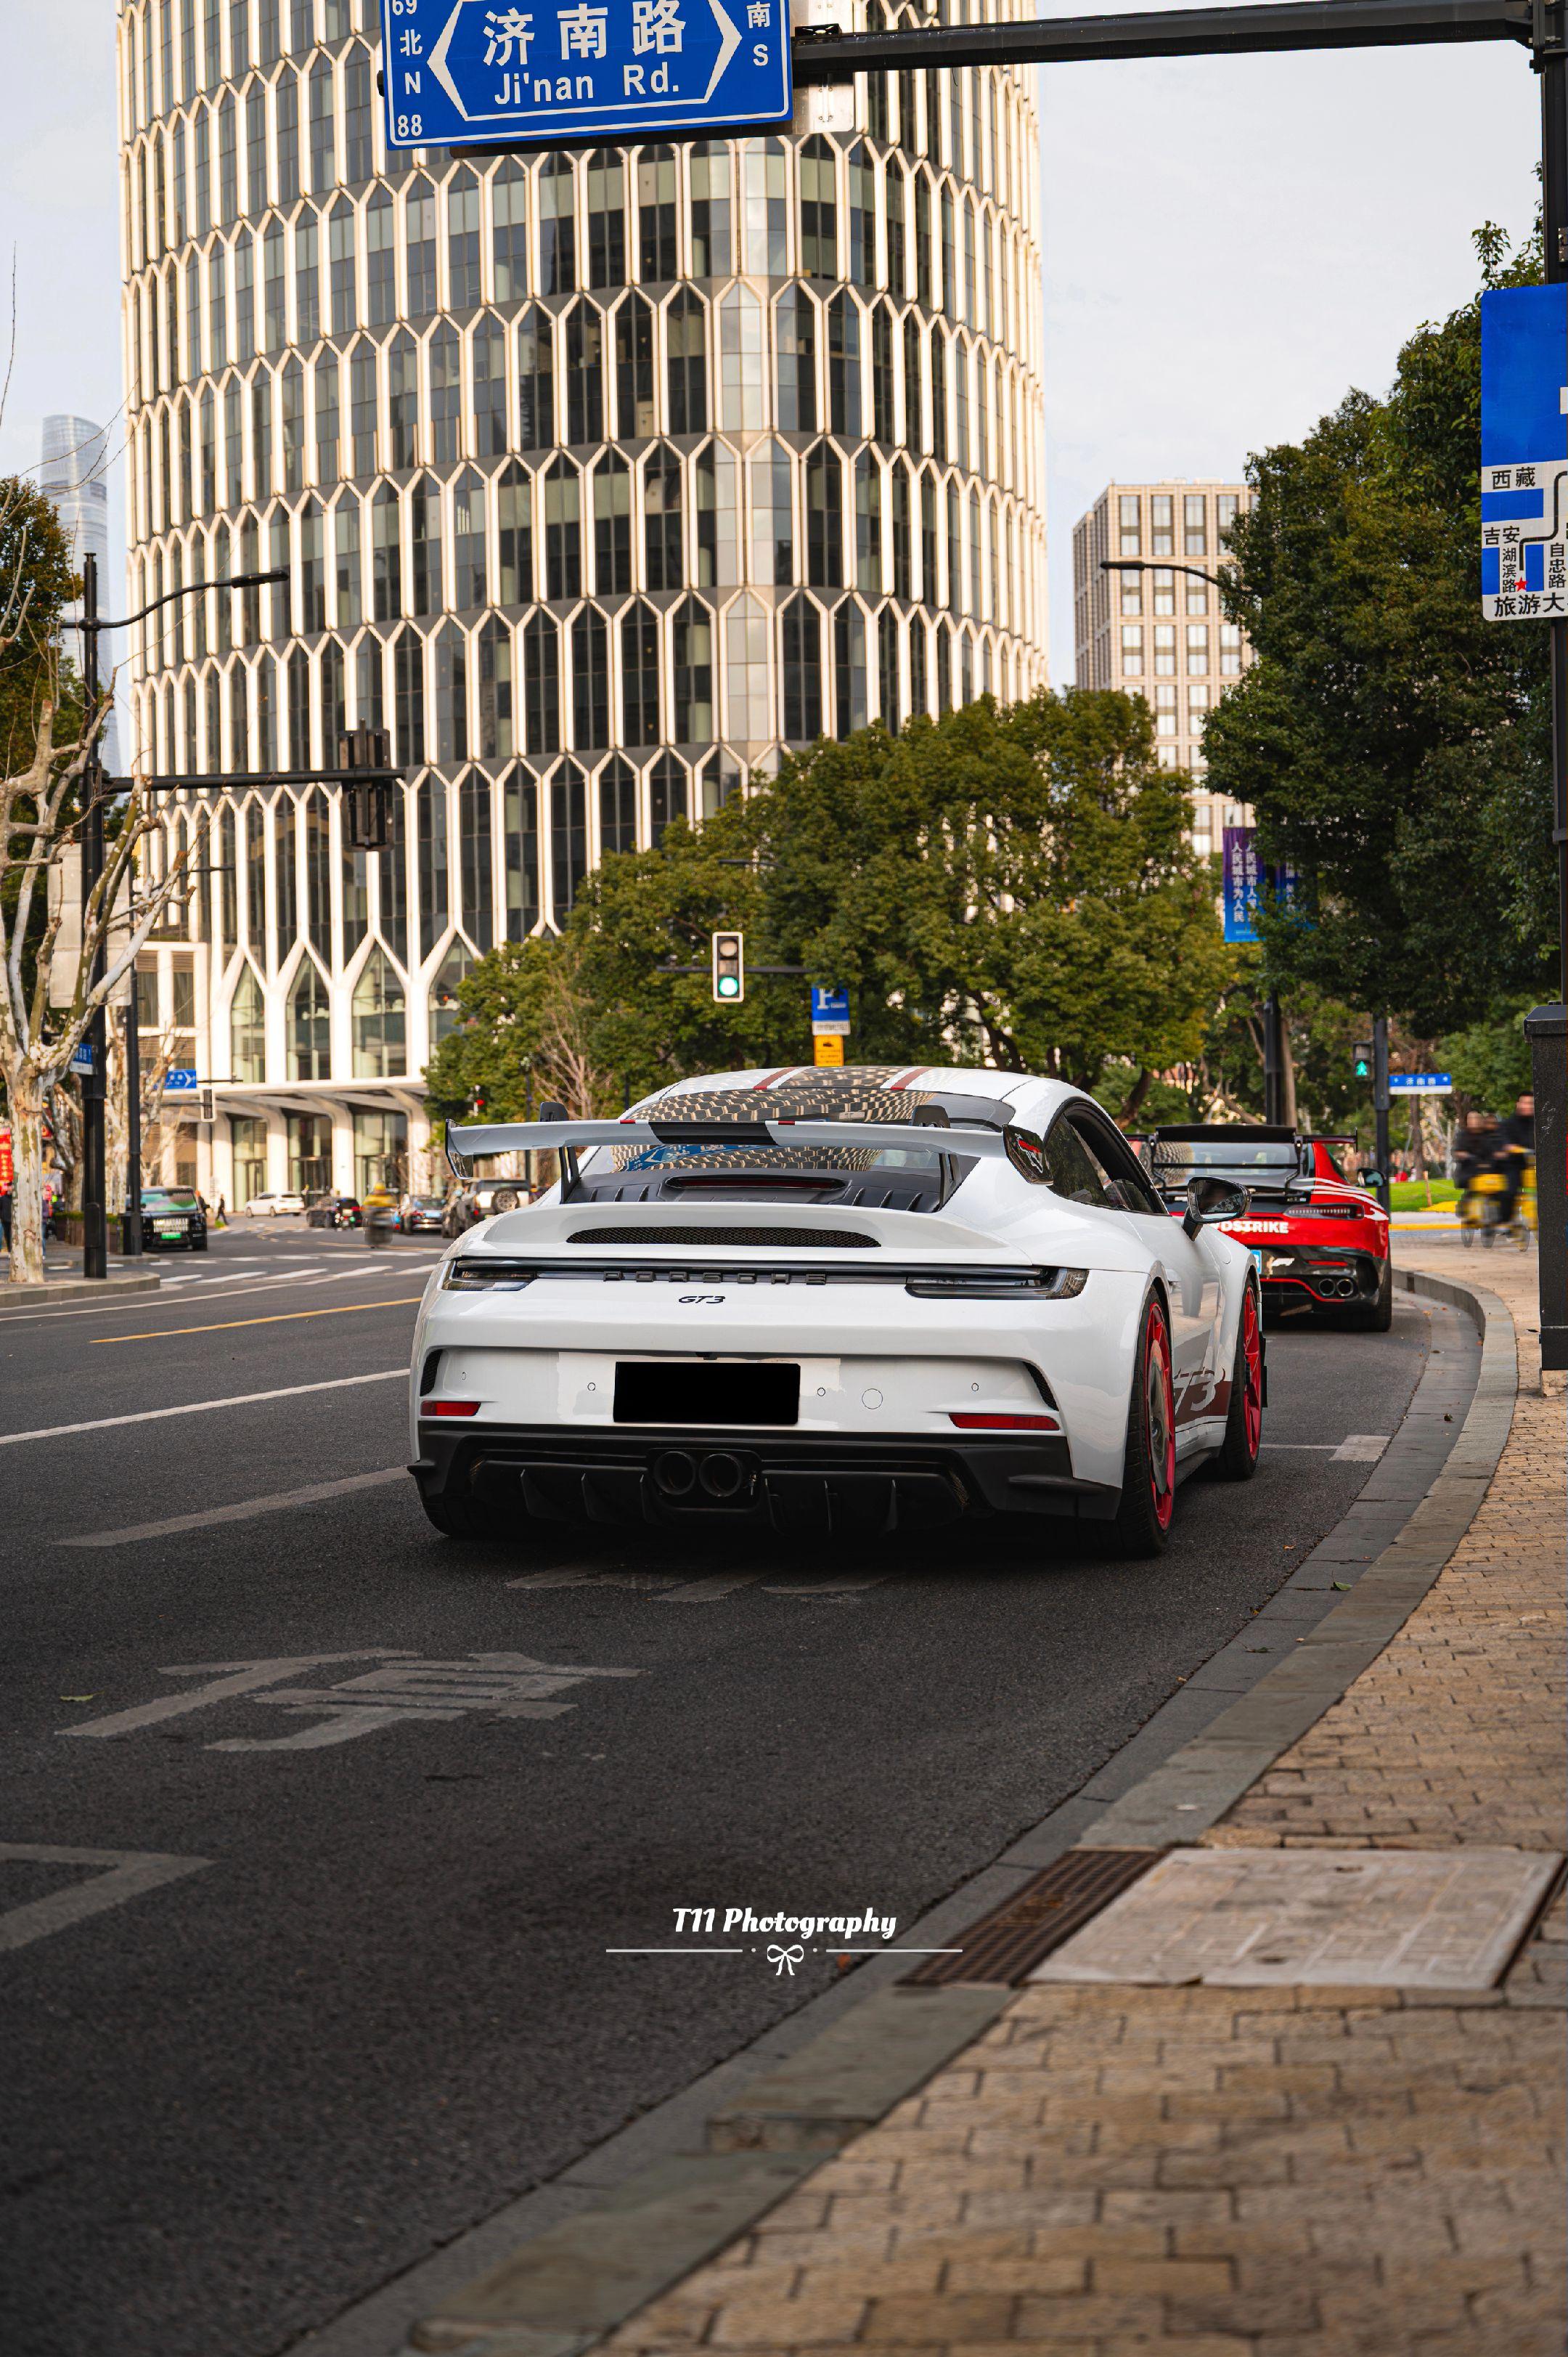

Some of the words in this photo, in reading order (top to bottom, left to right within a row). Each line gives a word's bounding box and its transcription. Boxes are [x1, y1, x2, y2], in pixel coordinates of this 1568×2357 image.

[392, 0, 417, 16] 69
[746, 1, 770, 28] 南
[400, 29, 422, 56] 北
[483, 0, 686, 66] 济南路
[753, 44, 768, 66] S
[404, 71, 421, 94] N
[494, 72, 594, 105] Ji'nan
[623, 61, 679, 96] Rd.
[398, 114, 422, 137] 88
[1492, 467, 1535, 489] 西藏
[1483, 526, 1520, 545] 吉安
[1502, 547, 1517, 593] 湖滨路
[1548, 542, 1567, 589] 自忠路
[1494, 593, 1568, 617] 旅游大
[603, 1271, 827, 1285] PORSCHE
[678, 1295, 726, 1304] GT3
